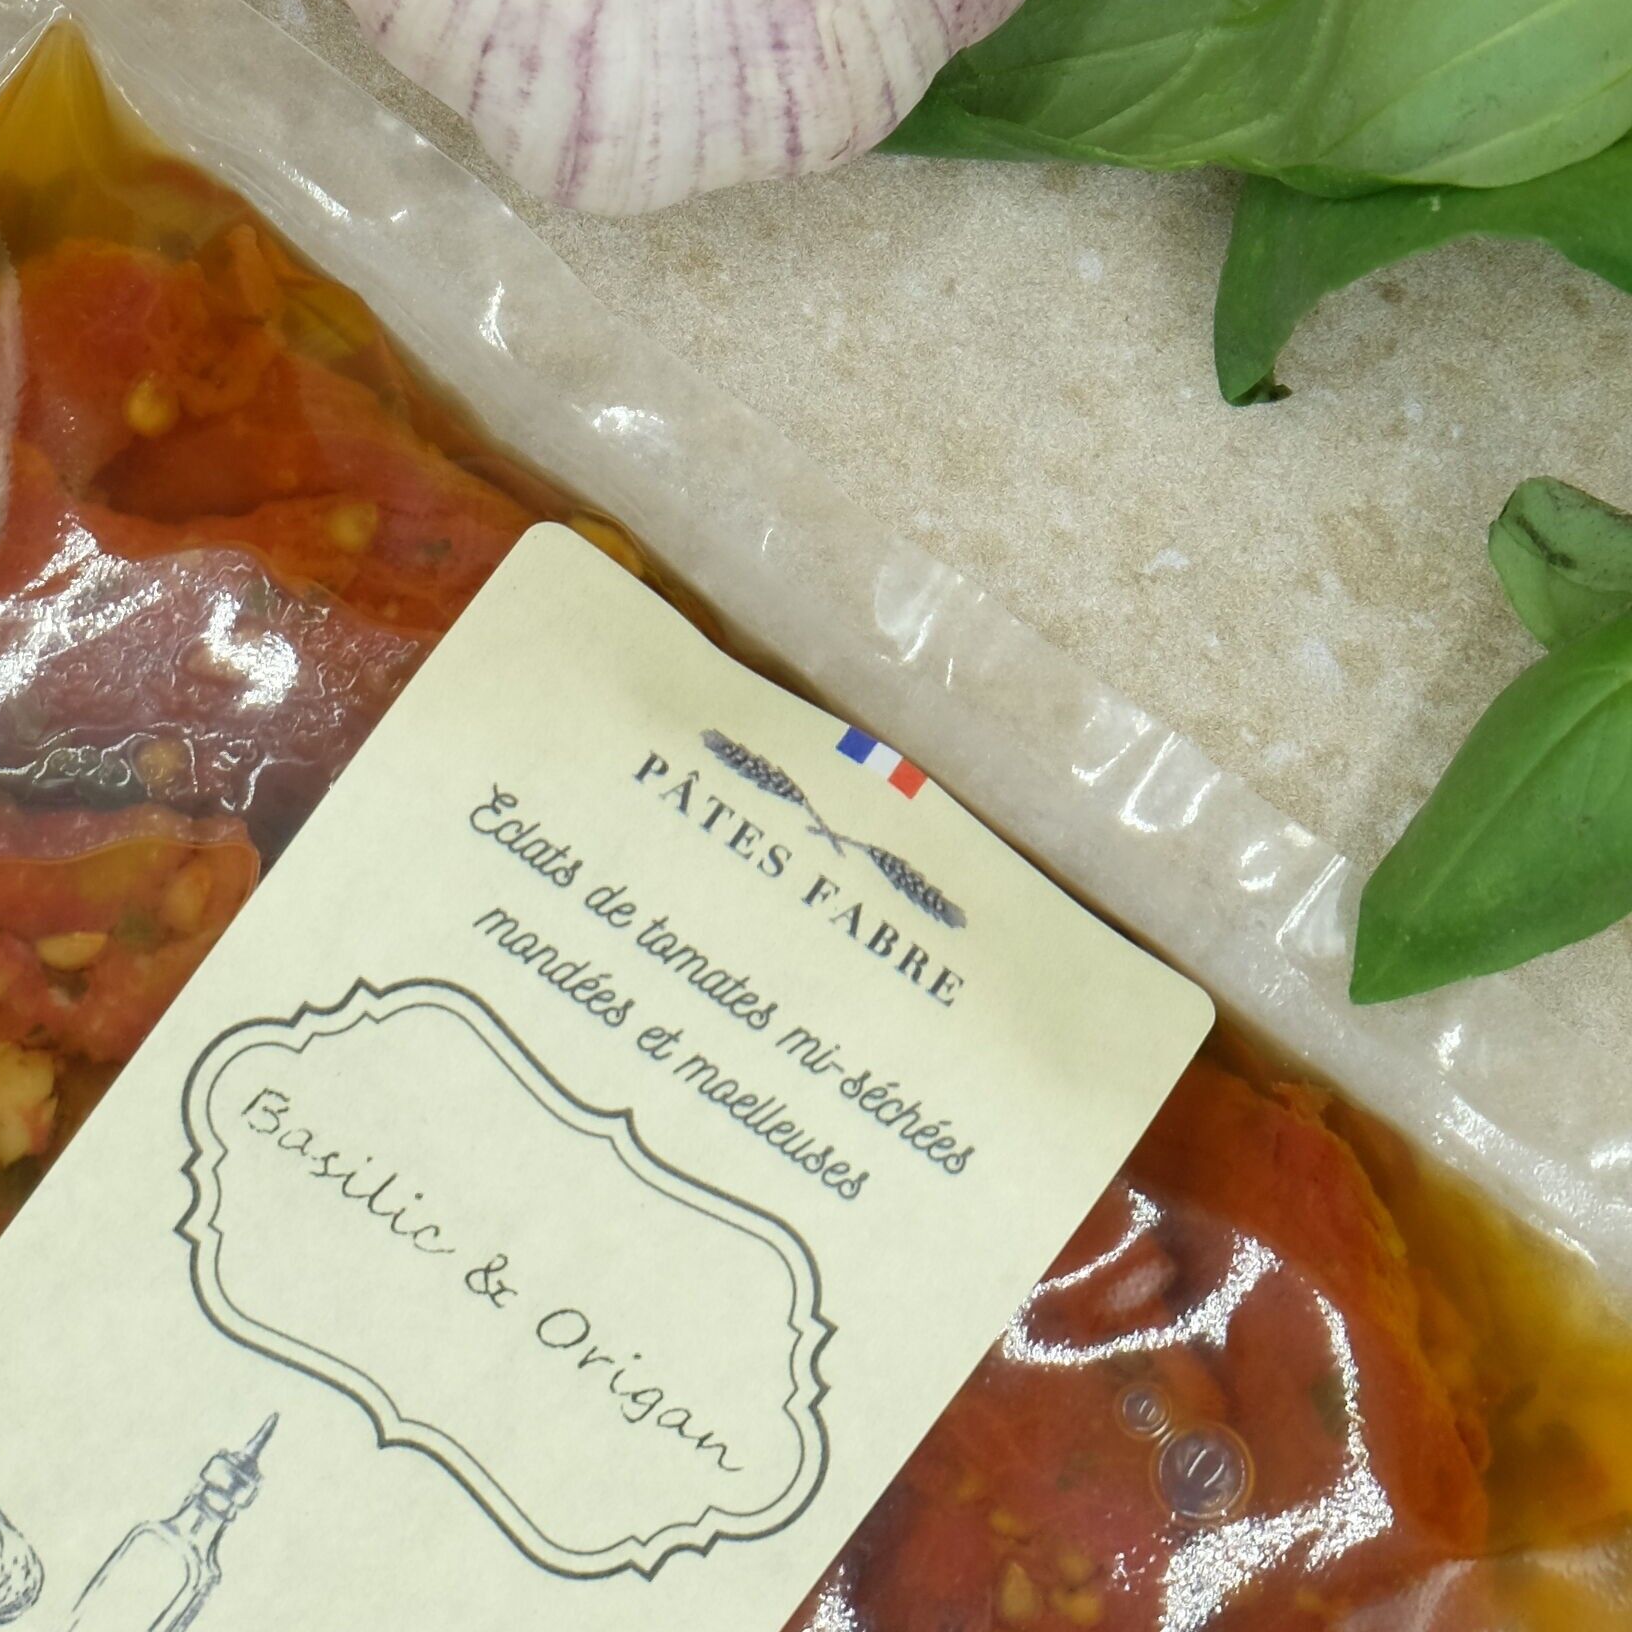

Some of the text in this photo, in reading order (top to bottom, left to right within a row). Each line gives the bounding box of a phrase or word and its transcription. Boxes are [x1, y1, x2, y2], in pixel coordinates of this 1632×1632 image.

[632, 750, 965, 1008] PÂTES FABRE
[471, 907, 871, 1202] mondées et moelleuses
[583, 885, 638, 929] de
[635, 915, 779, 1032] tomates
[774, 1025, 976, 1176] mi-séchées
[239, 1086, 745, 1474] Basilic & Origan
